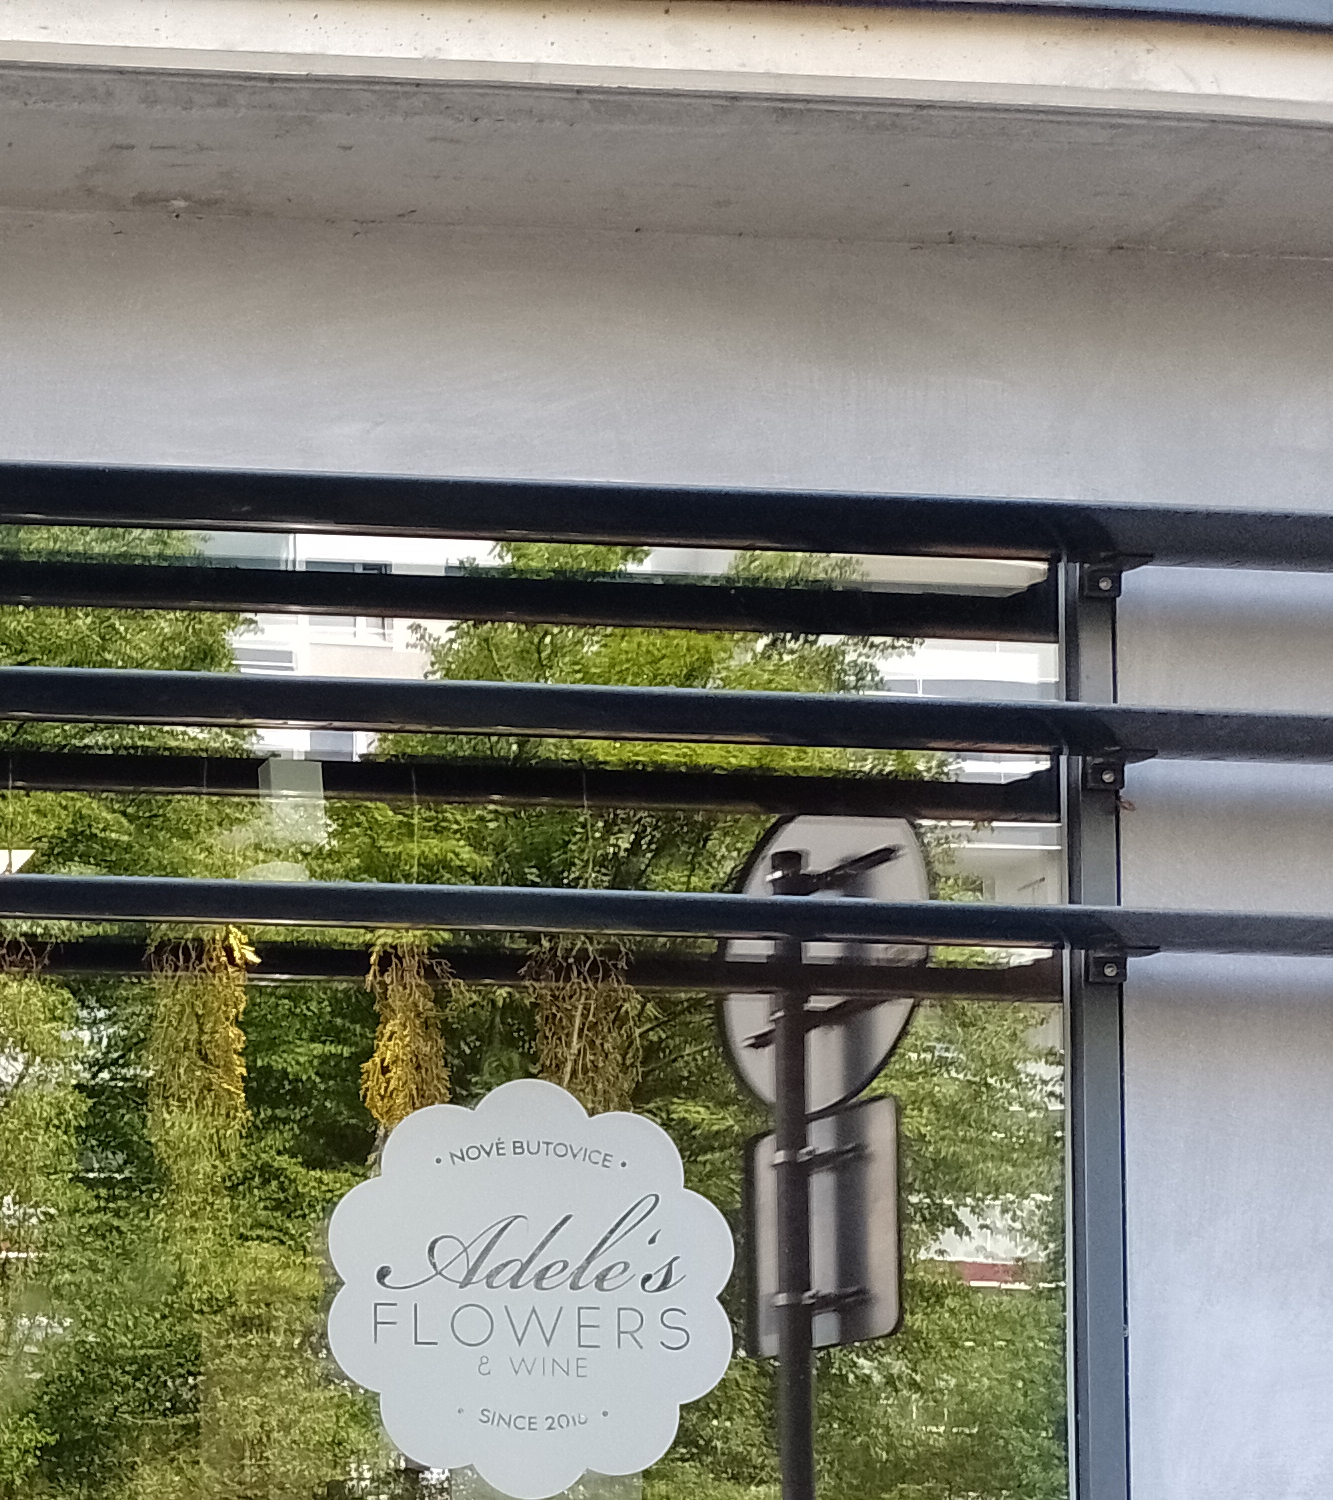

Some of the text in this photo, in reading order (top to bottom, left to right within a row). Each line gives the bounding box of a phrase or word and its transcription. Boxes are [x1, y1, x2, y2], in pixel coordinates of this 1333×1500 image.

[449, 1137, 614, 1169] NOVÉ BUTOVICE
[376, 1193, 686, 1293] Adele's
[373, 1303, 690, 1351] FLOWERS
[478, 1355, 588, 1378] & WINE
[478, 1408, 538, 1431] SINCE
